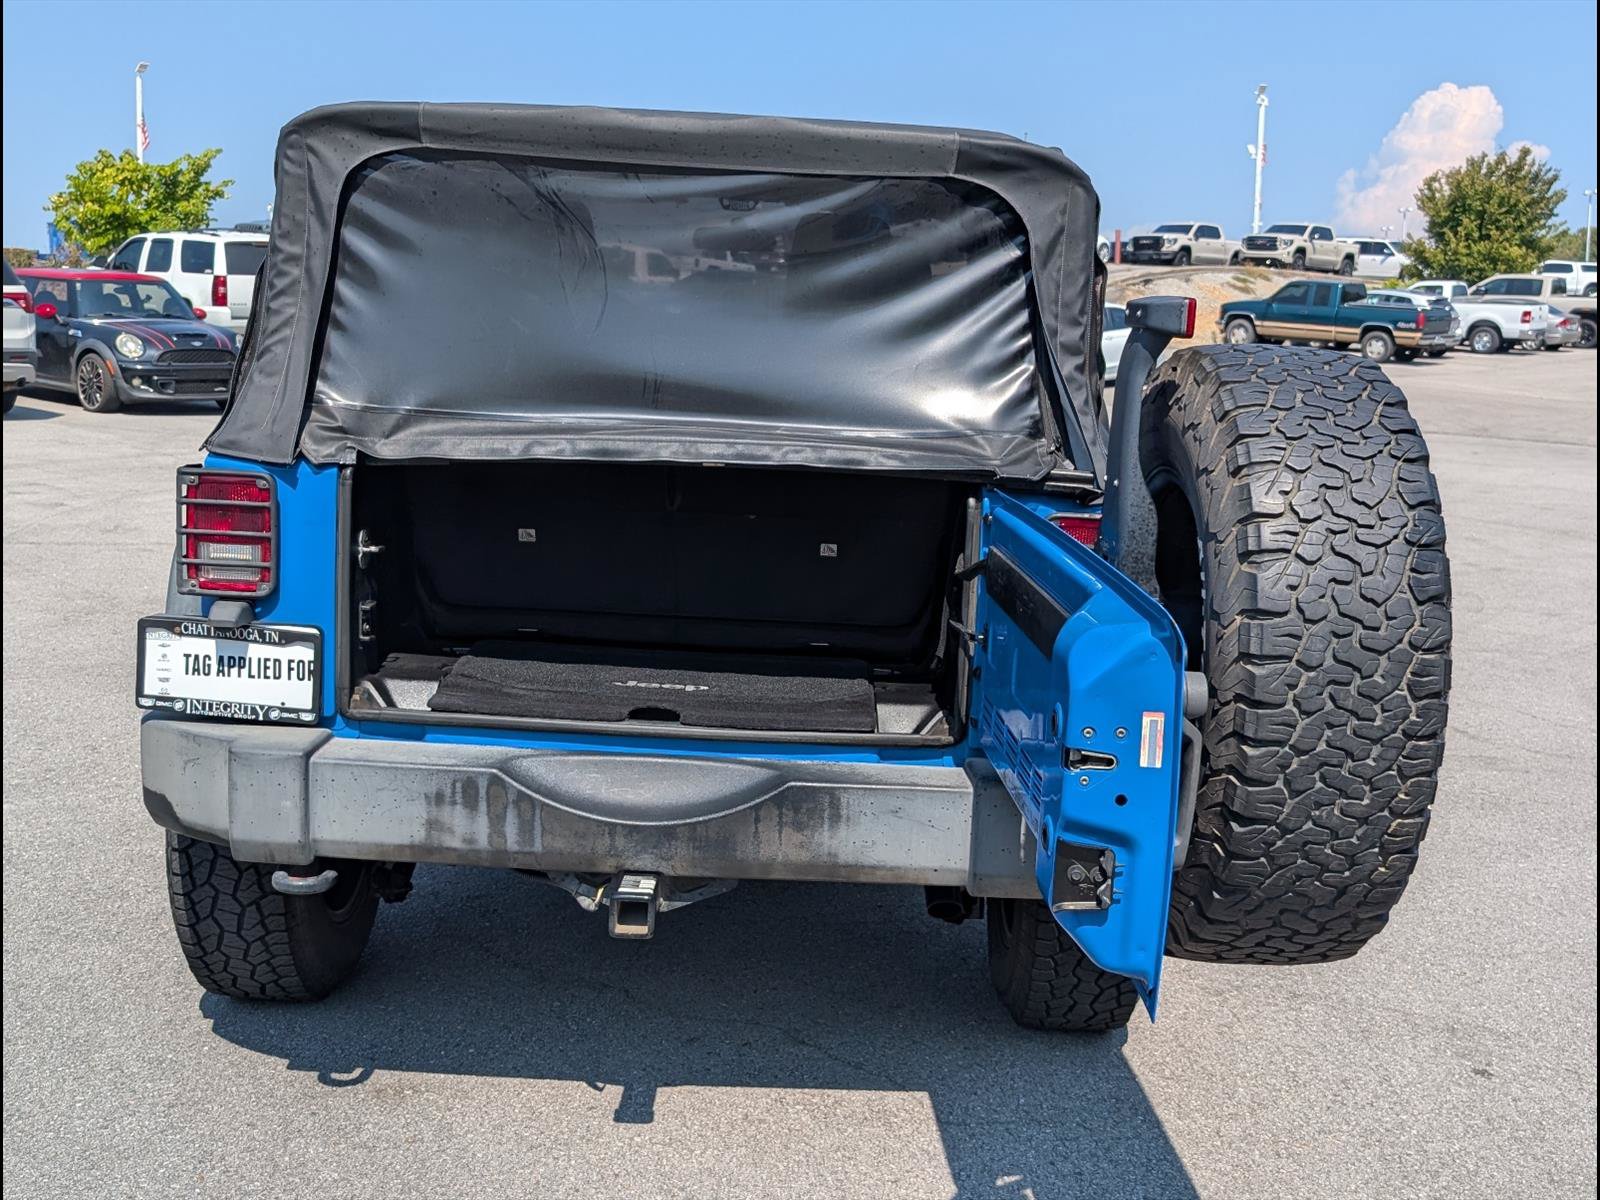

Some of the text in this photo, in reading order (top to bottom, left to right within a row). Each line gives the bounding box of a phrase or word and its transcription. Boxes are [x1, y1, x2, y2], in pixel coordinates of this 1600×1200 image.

[263, 630, 280, 643] TN
[183, 653, 212, 677] TAG
[216, 655, 282, 680] APPLIED
[611, 681, 709, 691] Jeep
[186, 698, 269, 721] INTEGRITY
